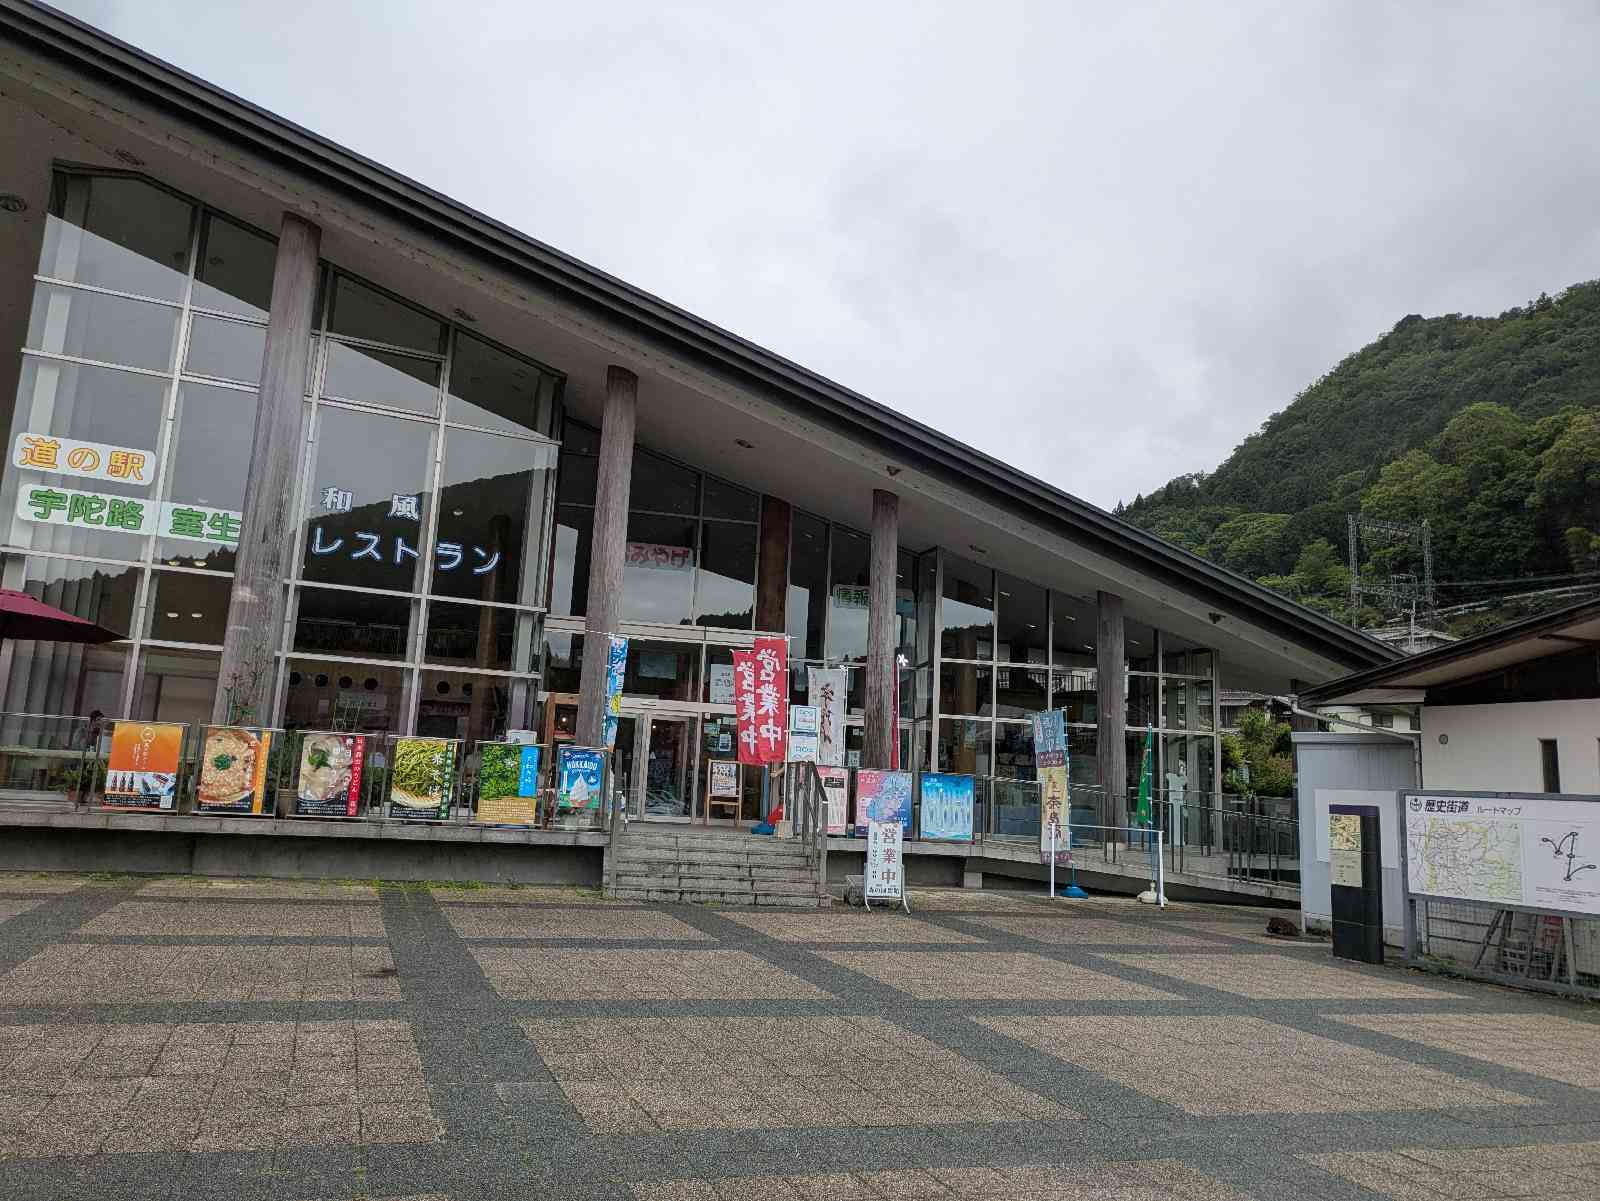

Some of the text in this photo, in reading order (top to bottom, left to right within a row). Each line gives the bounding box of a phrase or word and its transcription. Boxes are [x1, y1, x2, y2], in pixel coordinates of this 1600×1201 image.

[20, 436, 145, 481] 道の駅
[28, 488, 242, 543] 宇陀路 室生
[320, 487, 420, 521] 和風
[311, 527, 501, 576] レストラン
[756, 649, 781, 752] 営業中
[1425, 799, 1522, 816] 歴史街道 ルートマップ
[881, 828, 896, 884] 営業中
